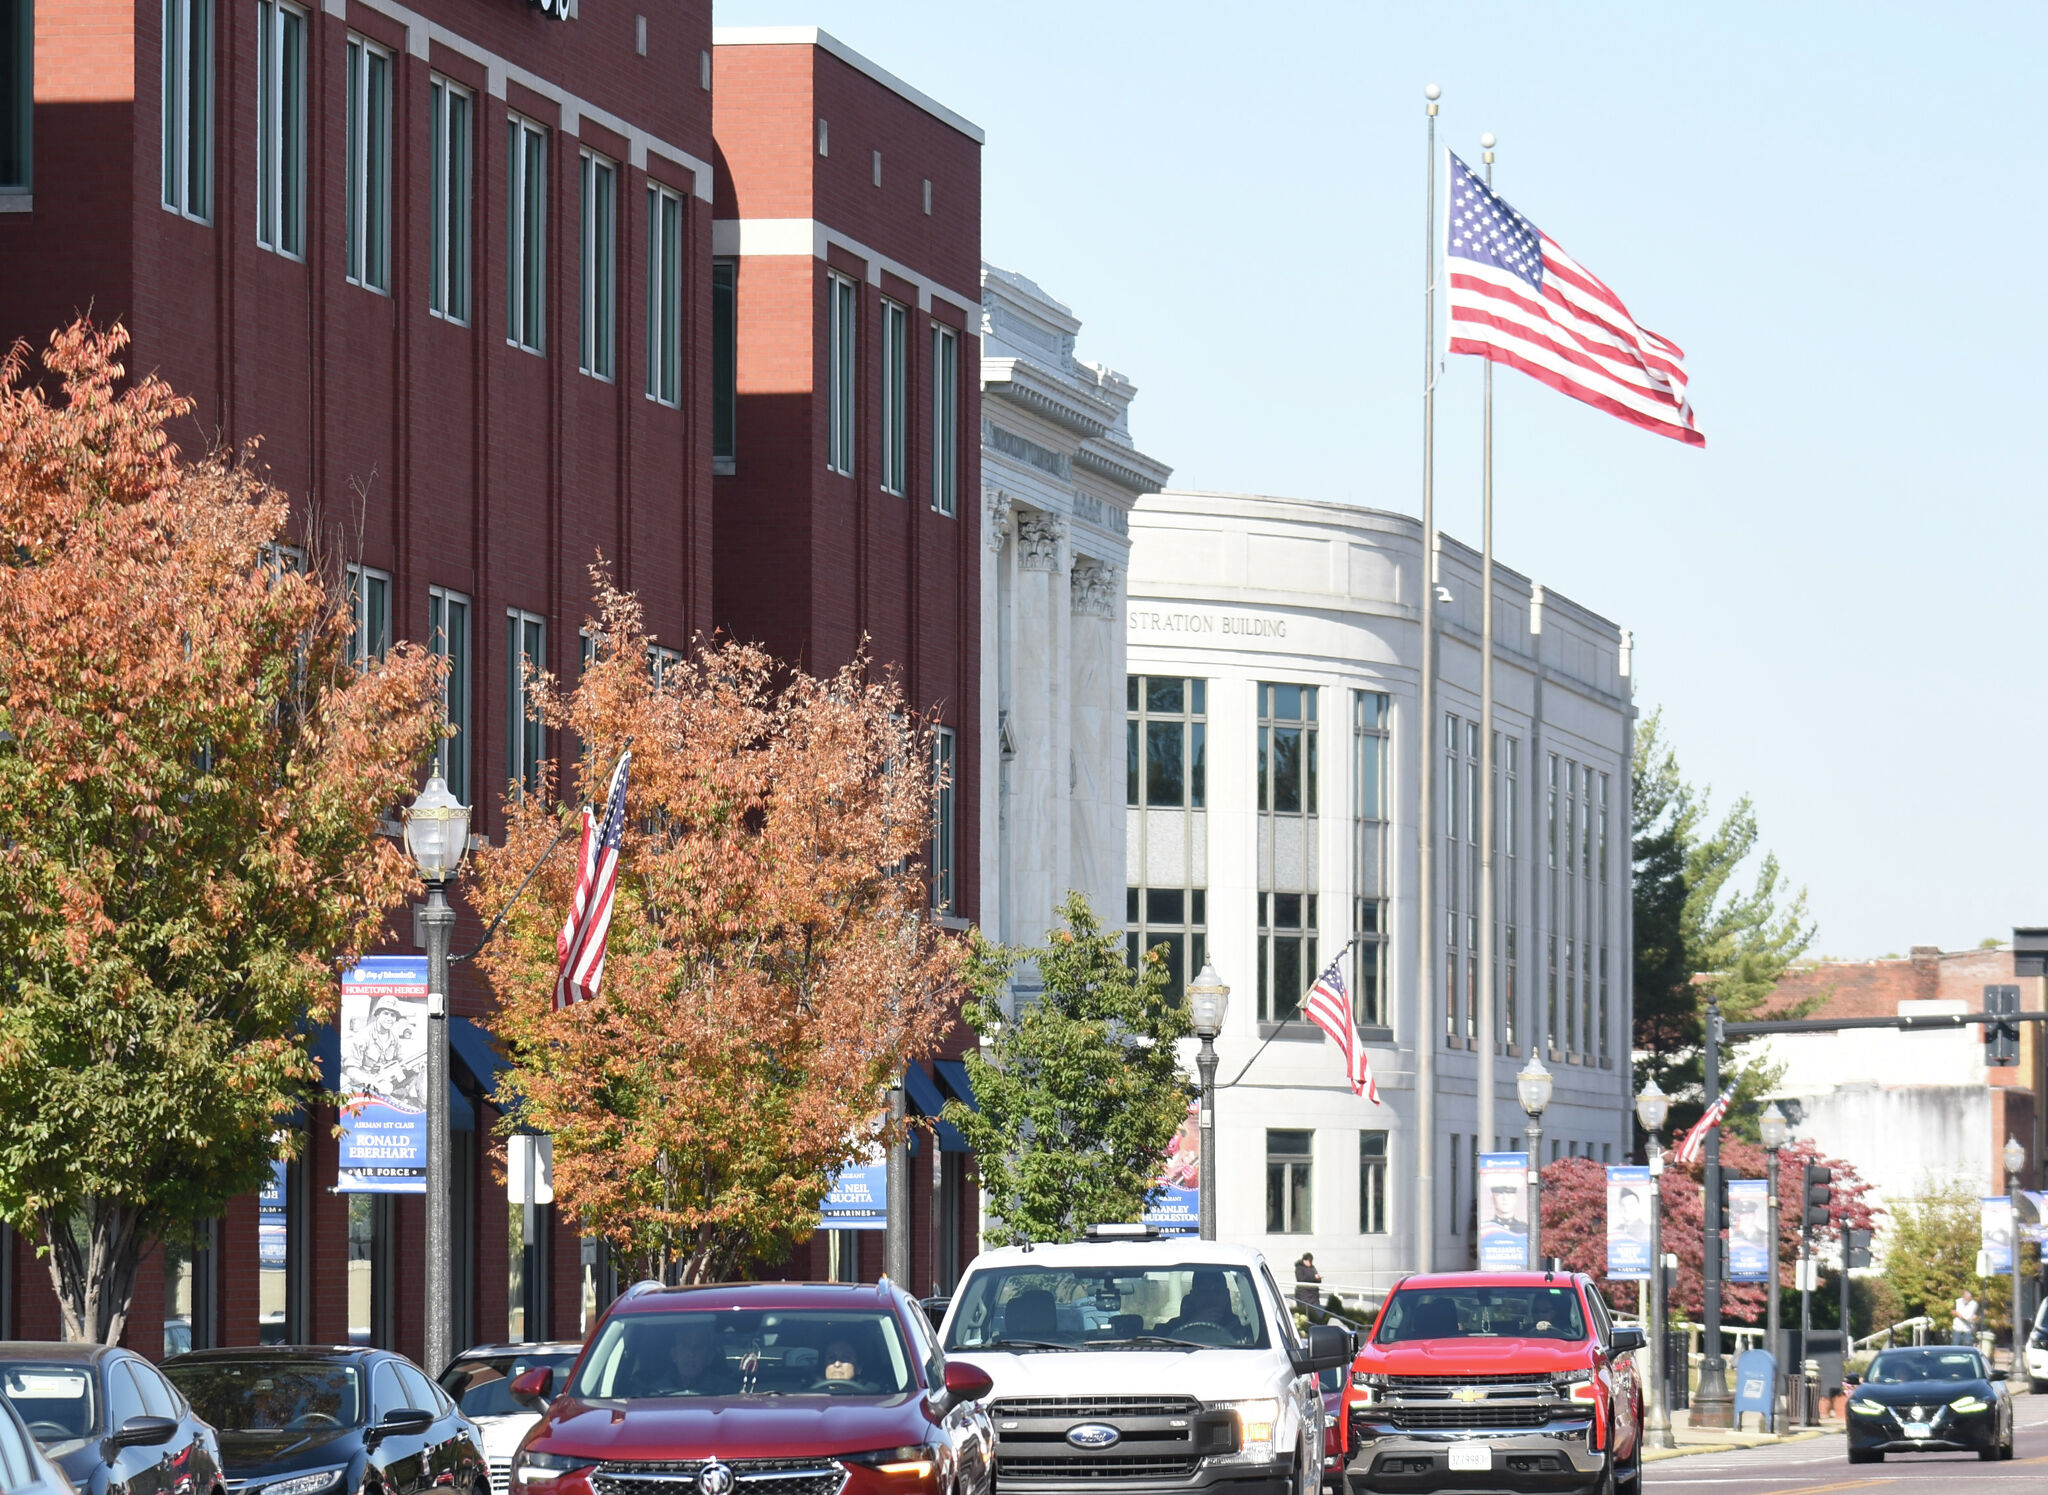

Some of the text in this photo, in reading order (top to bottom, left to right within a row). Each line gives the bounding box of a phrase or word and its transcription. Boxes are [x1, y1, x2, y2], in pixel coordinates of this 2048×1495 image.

[1222, 616, 1287, 638] BUILDING
[346, 986, 425, 994] HOMETOWN HEROES
[354, 1121, 415, 1129] AIRMAN 1ST CLASS
[356, 1135, 410, 1147] RONALD
[349, 1147, 417, 1159] EBERHART
[356, 1168, 410, 1176] AIR FORCE
[844, 1183, 870, 1193] NEIL
[830, 1193, 873, 1203] BUCHTA
